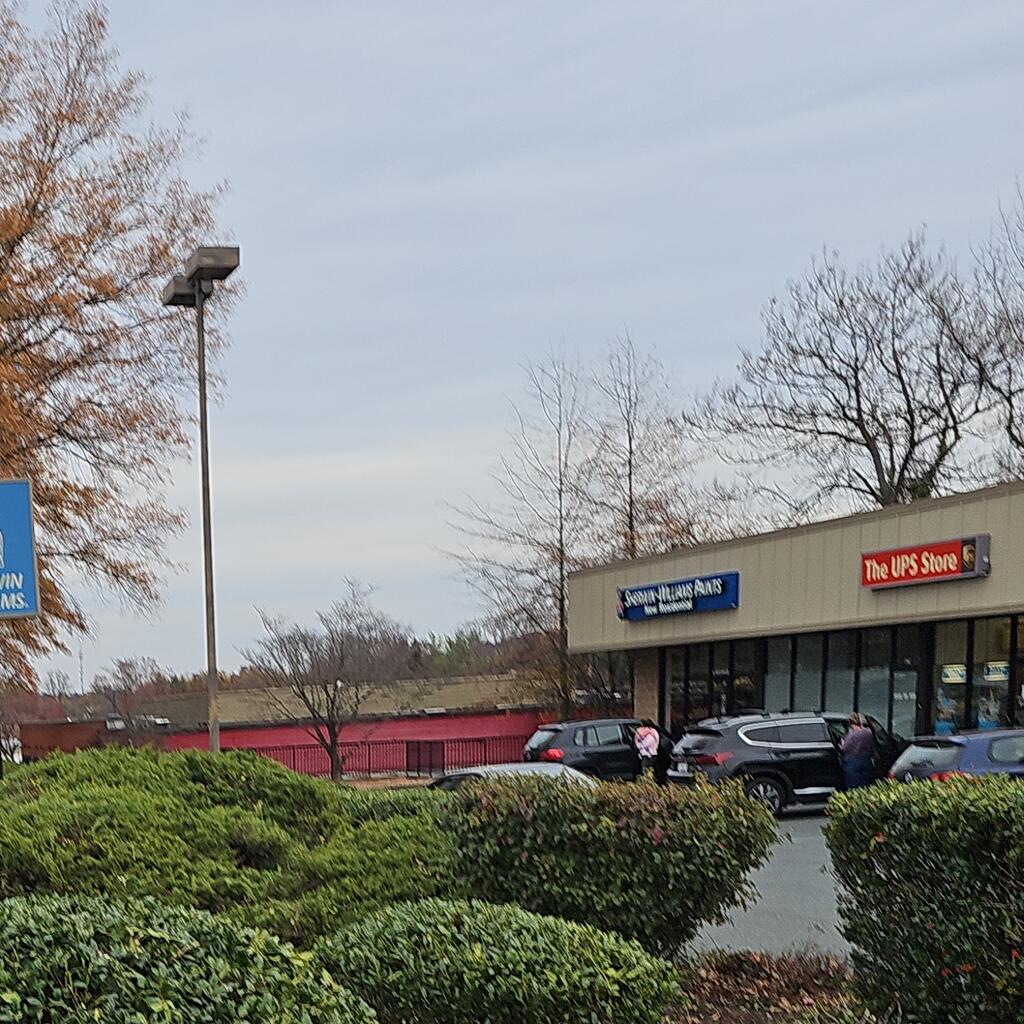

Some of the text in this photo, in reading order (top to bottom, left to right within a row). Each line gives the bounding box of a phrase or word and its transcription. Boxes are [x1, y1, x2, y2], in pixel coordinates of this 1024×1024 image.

[864, 550, 958, 582] The UPS Store
